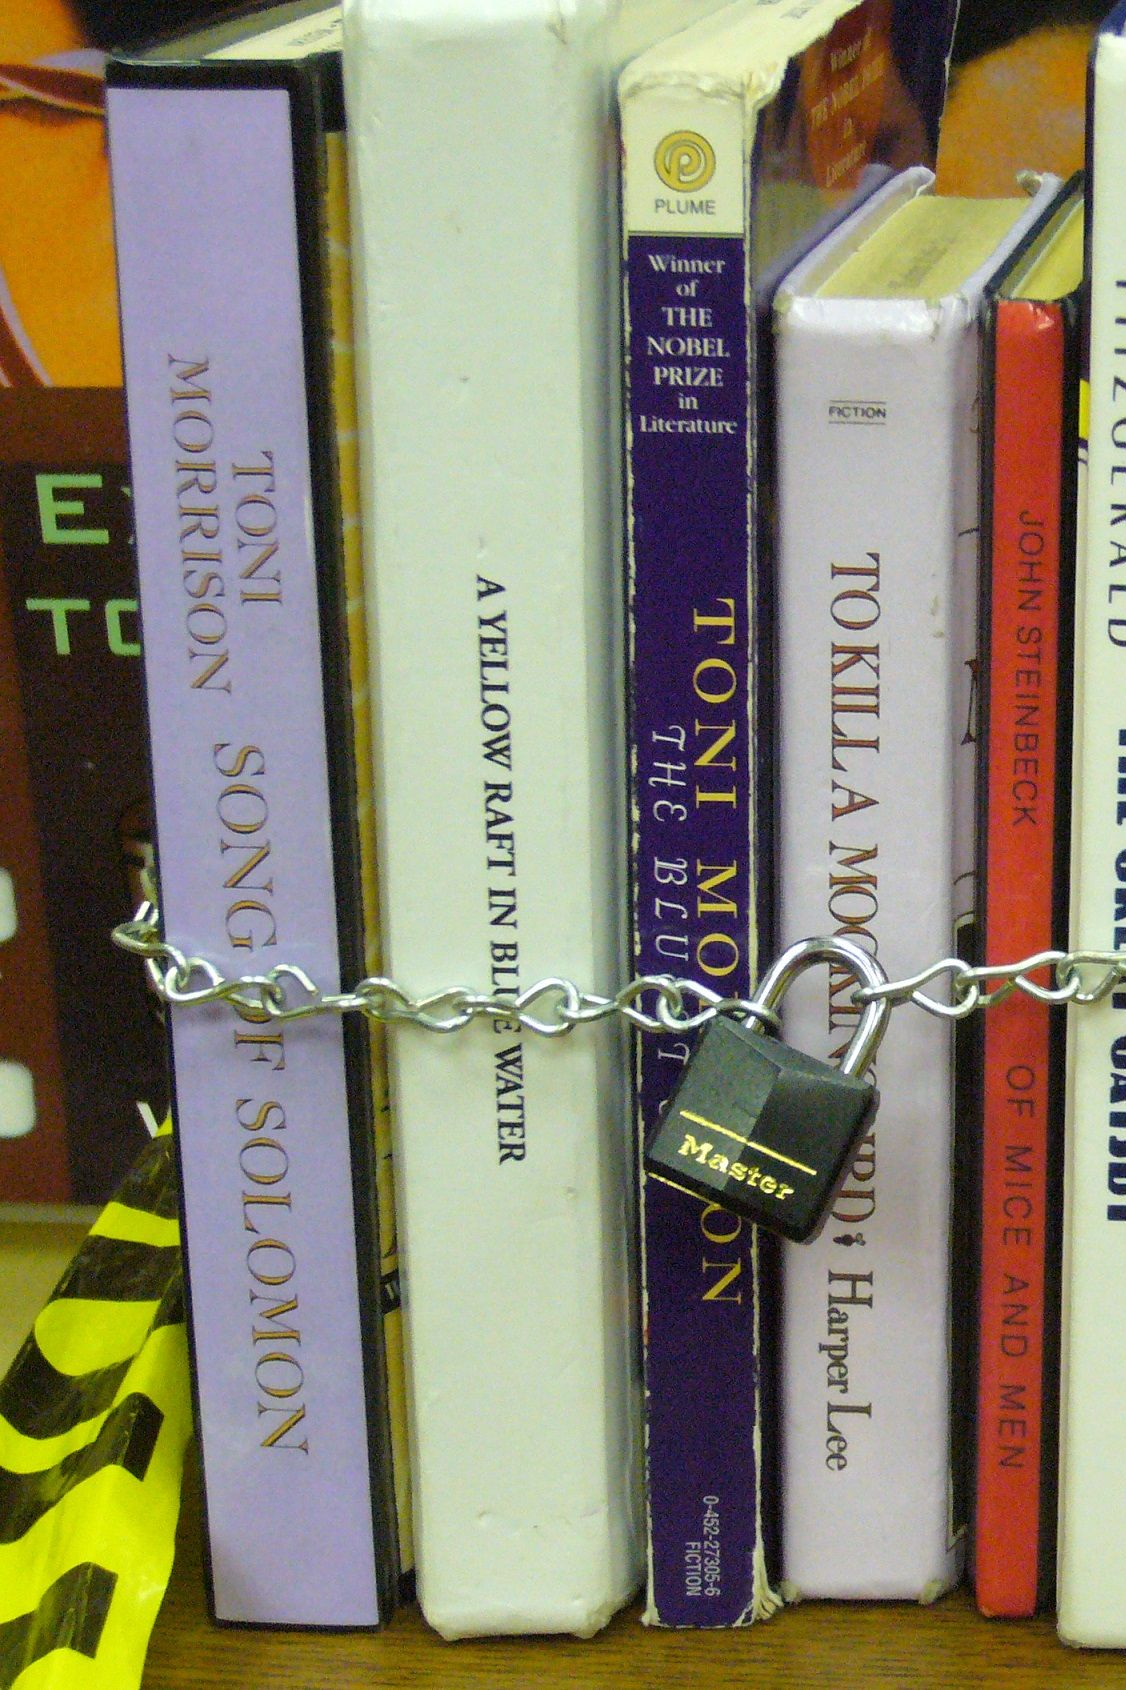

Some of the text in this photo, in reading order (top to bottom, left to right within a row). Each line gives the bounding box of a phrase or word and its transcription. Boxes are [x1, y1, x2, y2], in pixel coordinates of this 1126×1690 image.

[655, 199, 716, 215] PLUME
[648, 254, 725, 274] Winner
[676, 278, 698, 298] of
[647, 336, 730, 358] NOBEL
[662, 307, 713, 328] THE
[654, 367, 723, 387] PRIZE
[679, 394, 698, 410] in
[828, 405, 887, 420] FICTION
[640, 415, 738, 434] Literature
[168, 353, 232, 695] MORRISON
[232, 450, 283, 606] TONI
[476, 574, 506, 601] A
[830, 552, 881, 632] TO
[479, 611, 512, 774] YELLOW
[693, 598, 738, 808] TONI
[831, 641, 881, 772] KILL
[1011, 510, 1045, 828] JOHN STEINBECK
[648, 724, 688, 823] THE
[832, 779, 880, 822] A
[212, 742, 278, 951] SONG
[484, 779, 516, 876] RAFT
[487, 887, 518, 929] IN
[495, 1043, 527, 1166] WATER
[678, 1133, 796, 1201] Master
[236, 1098, 310, 1455] SOLOMON
[1000, 1066, 1035, 1470] OF MICE AND MEN
[818, 1268, 874, 1472] Harper Lee
[684, 1541, 703, 1596] FICTION
[703, 1495, 722, 1597] 0-452-27305-6
